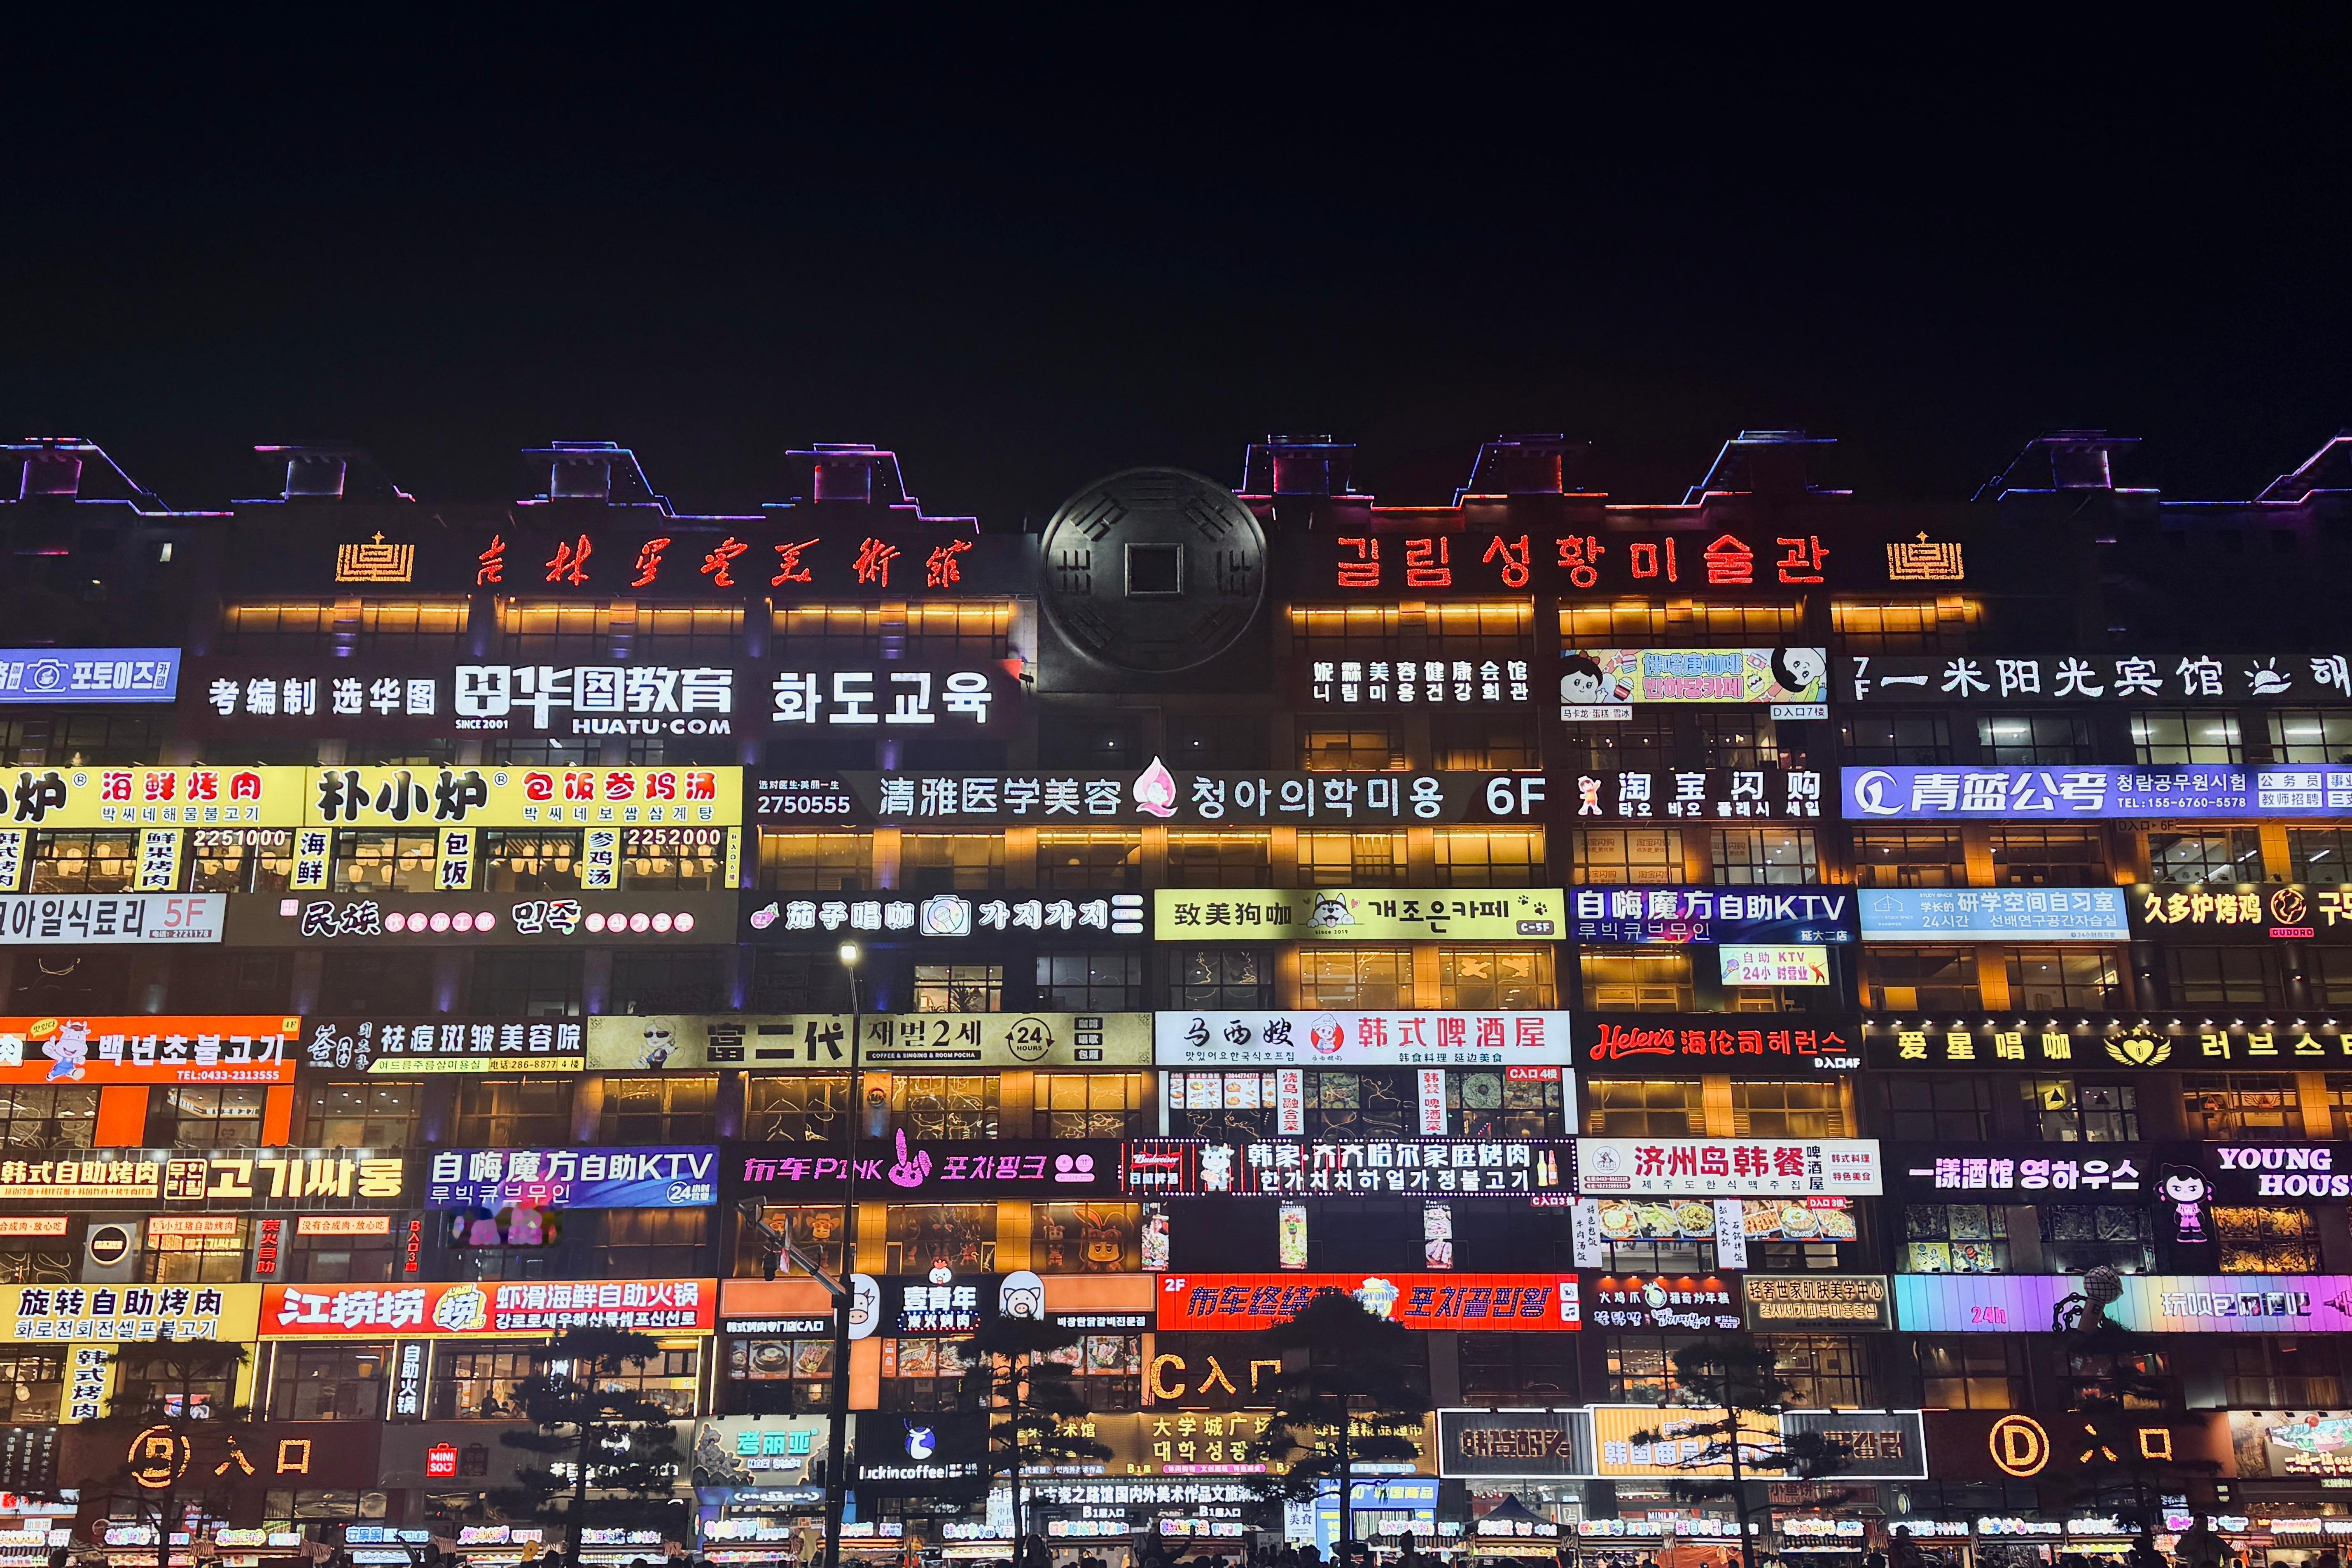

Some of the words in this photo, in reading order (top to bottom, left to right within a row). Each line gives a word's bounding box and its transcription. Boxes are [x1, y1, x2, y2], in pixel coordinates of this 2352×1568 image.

[1337, 533, 1829, 588] 길림성황미술관
[70, 661, 156, 689] 포토이즈
[1313, 661, 1528, 682] 妮霖美容健康会馆
[1880, 655, 2224, 698] 一米阳光宾馆
[209, 678, 316, 716] 考编制
[332, 678, 436, 716] 选华图
[511, 666, 733, 729] 华图教育
[771, 672, 992, 723] 화도교육
[1313, 684, 1529, 702] 니림미용건강회관
[455, 720, 481, 729] SINCE
[483, 720, 508, 729] 2001
[1773, 707, 1825, 717] D入口7楼
[102, 771, 263, 801] 海鲜烤肉
[1619, 771, 1822, 801] 淘宝闪购
[1910, 772, 2107, 811] 青蓝公考
[2116, 773, 2247, 793] 청람공무원시험
[2261, 775, 2319, 787] 公务员
[318, 770, 488, 822] 朴小炉
[523, 771, 717, 802] 包饭参鸡汤
[757, 796, 850, 814] 2750555
[879, 777, 1121, 816] 清雅医学美容
[1191, 776, 1443, 819] 청아의학미용
[1486, 776, 1546, 815] 6F
[2117, 797, 2247, 809] TEL:155-6760-5578
[2262, 793, 2319, 806] 教师招聘
[102, 806, 260, 822] 박씨네해물불고기
[523, 806, 713, 821] 박씨네보쌈삼계탕
[1619, 802, 1653, 817] 타오
[1668, 802, 1703, 817] 바오
[1717, 802, 1770, 817] 플래시
[1786, 802, 1821, 817] 세일
[193, 830, 286, 846] 2251000
[628, 829, 721, 846] 2252000
[2118, 820, 2150, 832] D入口
[2160, 820, 2175, 832] 6F
[141, 831, 177, 887] 鲜果烤肉
[296, 832, 325, 885] 海鲜
[441, 832, 469, 886] 包饭
[586, 830, 613, 885] 参鸡汤
[164, 898, 206, 928] 5F
[785, 901, 915, 929] 茄子唱咖
[979, 900, 1108, 930] 가지가지
[1920, 902, 1955, 914] 学长的
[1957, 892, 2116, 913] 研学空间自习室
[2144, 892, 2262, 924] 久多炉烤鸡
[301, 900, 381, 937] 民族
[513, 900, 581, 935] 민족
[1174, 902, 1292, 926] 致美狗咖
[1368, 900, 1509, 933] 개조은카페
[1520, 922, 1551, 933] C-5F
[1922, 914, 1970, 929] 24시간
[1990, 914, 2117, 928] 선배연구공간자습실
[172, 930, 210, 939] 2721178
[1578, 923, 1710, 940] 루빅큐브무인
[1801, 930, 1847, 942] 延大二店
[1743, 952, 1769, 963] 自助
[1778, 952, 1805, 963] KTV
[381, 1024, 581, 1053] 祛痘斑皱美容院
[707, 1021, 844, 1062] 富二代
[867, 1019, 981, 1047] 재벌2세
[1017, 1027, 1042, 1044] 24
[1358, 1017, 1546, 1048] 韩式啤酒屋
[1589, 1024, 1676, 1060] Helen's
[1680, 1030, 1763, 1055] 海伦司
[1767, 1030, 1847, 1056] 헤런스
[98, 1033, 285, 1067] 백년초불고기
[1186, 1051, 1295, 1062] 맛있어요한국식호프집
[1399, 1052, 1447, 1063] 韩食料理
[1454, 1052, 1502, 1063] 延边美食
[1899, 1031, 2072, 1061] 爱星唱咖
[177, 1071, 280, 1081] TEL:0433-2313555
[1509, 1069, 1538, 1080] C入口
[1814, 1058, 1861, 1069] D入口4F
[941, 1155, 1048, 1180] 포차핑크
[1133, 1152, 1180, 1165] Budweiser
[1635, 1145, 1804, 1178] 济州岛韩餐
[1807, 1145, 1823, 1190] 啤酒屋
[2217, 1147, 2332, 1170] YOUNG
[1, 1160, 159, 1185] 韩式自助烤肉
[207, 1159, 403, 1198] 고기싸롱
[1642, 1179, 1801, 1190] 제주도한식맥주집
[1908, 1158, 2014, 1190] 一漾酒馆
[2020, 1159, 2140, 1191] 영하우스
[2258, 1174, 2352, 1196] HOUS
[430, 1185, 570, 1205] 루빅큐브무인
[670, 1184, 691, 1200] 24
[495, 1282, 699, 1310] 虾滑海鲜自助火锅
[1165, 1278, 1186, 1292] 2F
[1599, 1291, 1641, 1304] 火鸡爪
[1749, 1280, 1883, 1300] 轻奢世家肌肤美学中心
[18, 1289, 222, 1316] 旋转自助烤肉
[278, 1288, 425, 1328] 江捞捞
[903, 1285, 977, 1311] 壹青年
[1971, 1306, 2007, 1324] 24h
[70, 1350, 108, 1419] 韩式烤肉
[397, 1344, 421, 1414] 自助火锅
[736, 1430, 810, 1456] 考丽亚
[430, 1452, 453, 1461] MINI
